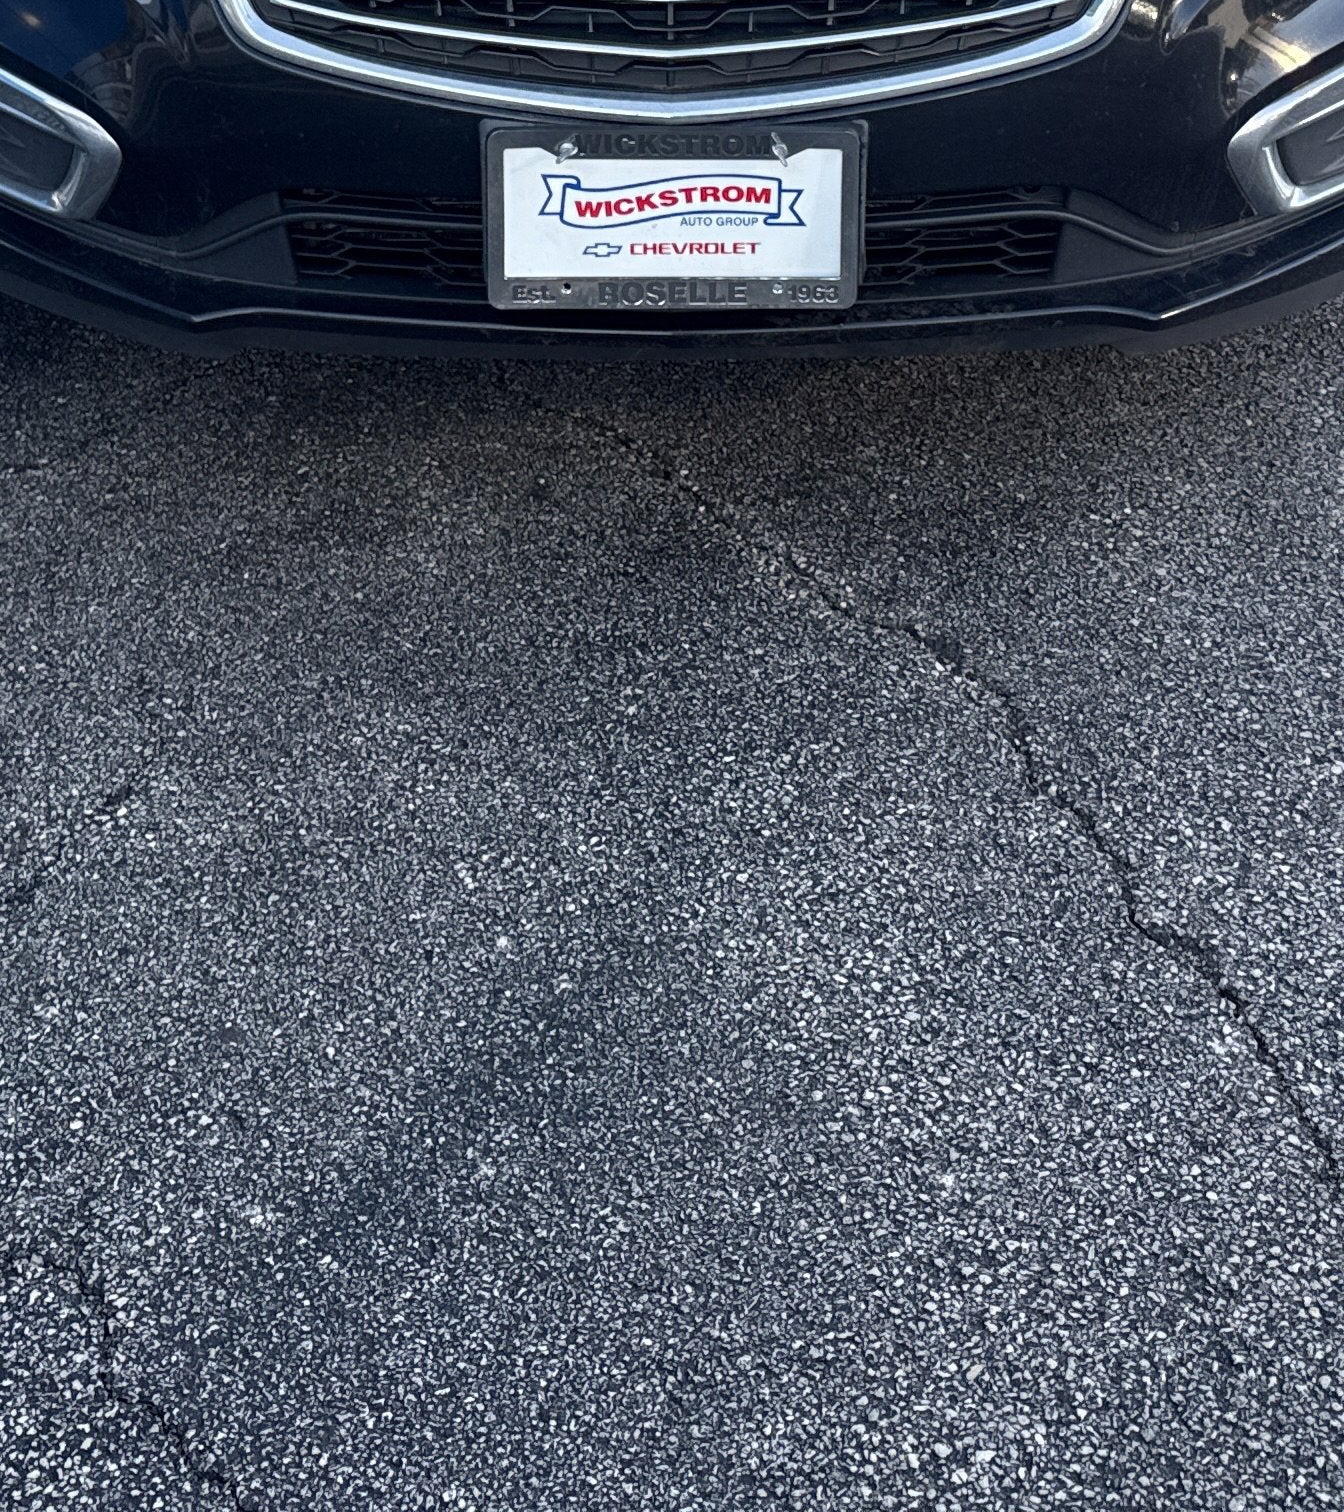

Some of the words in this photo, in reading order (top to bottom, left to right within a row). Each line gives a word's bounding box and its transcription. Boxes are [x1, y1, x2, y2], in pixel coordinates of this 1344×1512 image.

[574, 133, 772, 156] WICKSTROM
[575, 185, 772, 218] WICKSTROM
[680, 216, 713, 227] AUTO
[716, 216, 759, 227] GROUP
[629, 242, 762, 256] CHEVROLET
[598, 281, 748, 306] ROSELLE
